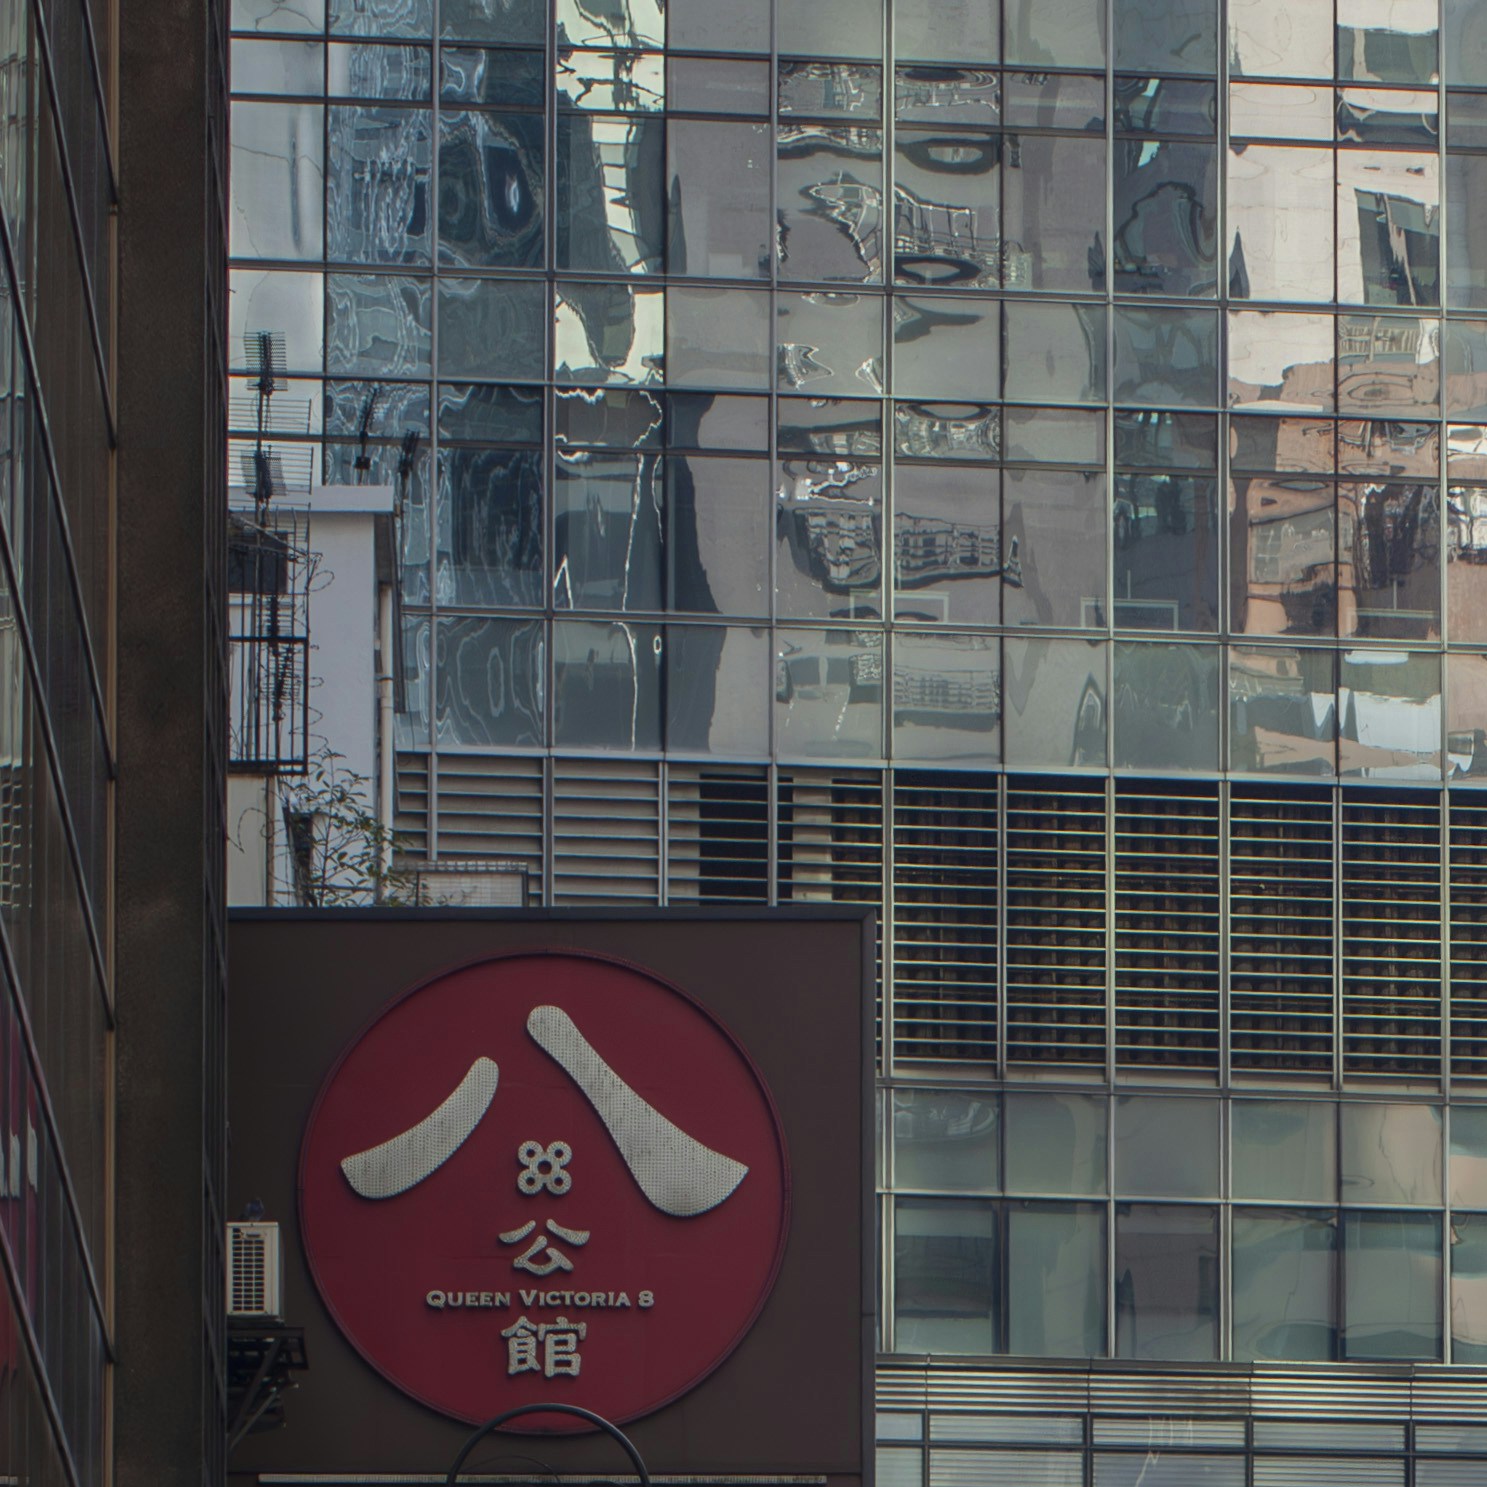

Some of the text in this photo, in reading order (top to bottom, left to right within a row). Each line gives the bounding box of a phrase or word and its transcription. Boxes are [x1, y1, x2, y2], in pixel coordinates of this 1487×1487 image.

[426, 1289, 655, 1310] QUEEN VICTORIA 8
[501, 1316, 587, 1378] 館
